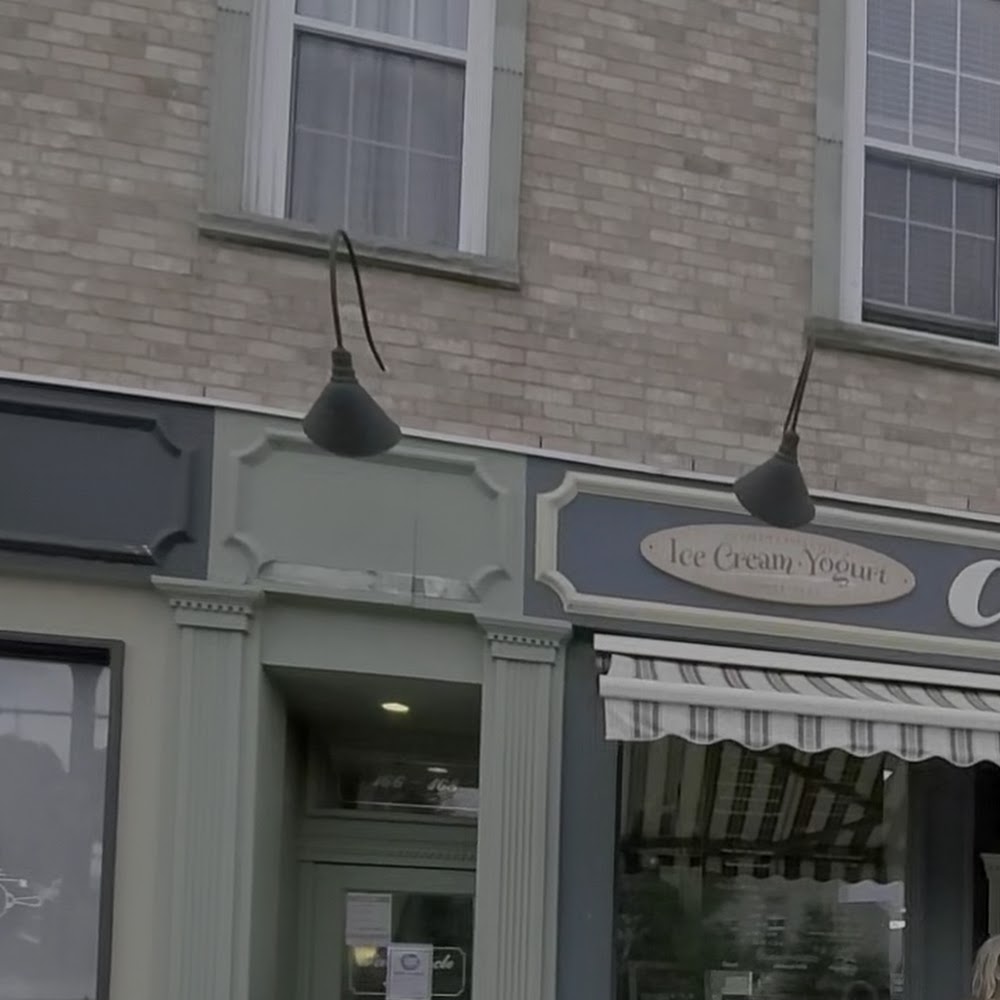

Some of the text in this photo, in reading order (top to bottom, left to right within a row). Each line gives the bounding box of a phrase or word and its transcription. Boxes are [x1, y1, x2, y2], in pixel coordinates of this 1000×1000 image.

[669, 538, 705, 566] Ice
[713, 542, 793, 575] Cream
[804, 548, 887, 586] Yogurt
